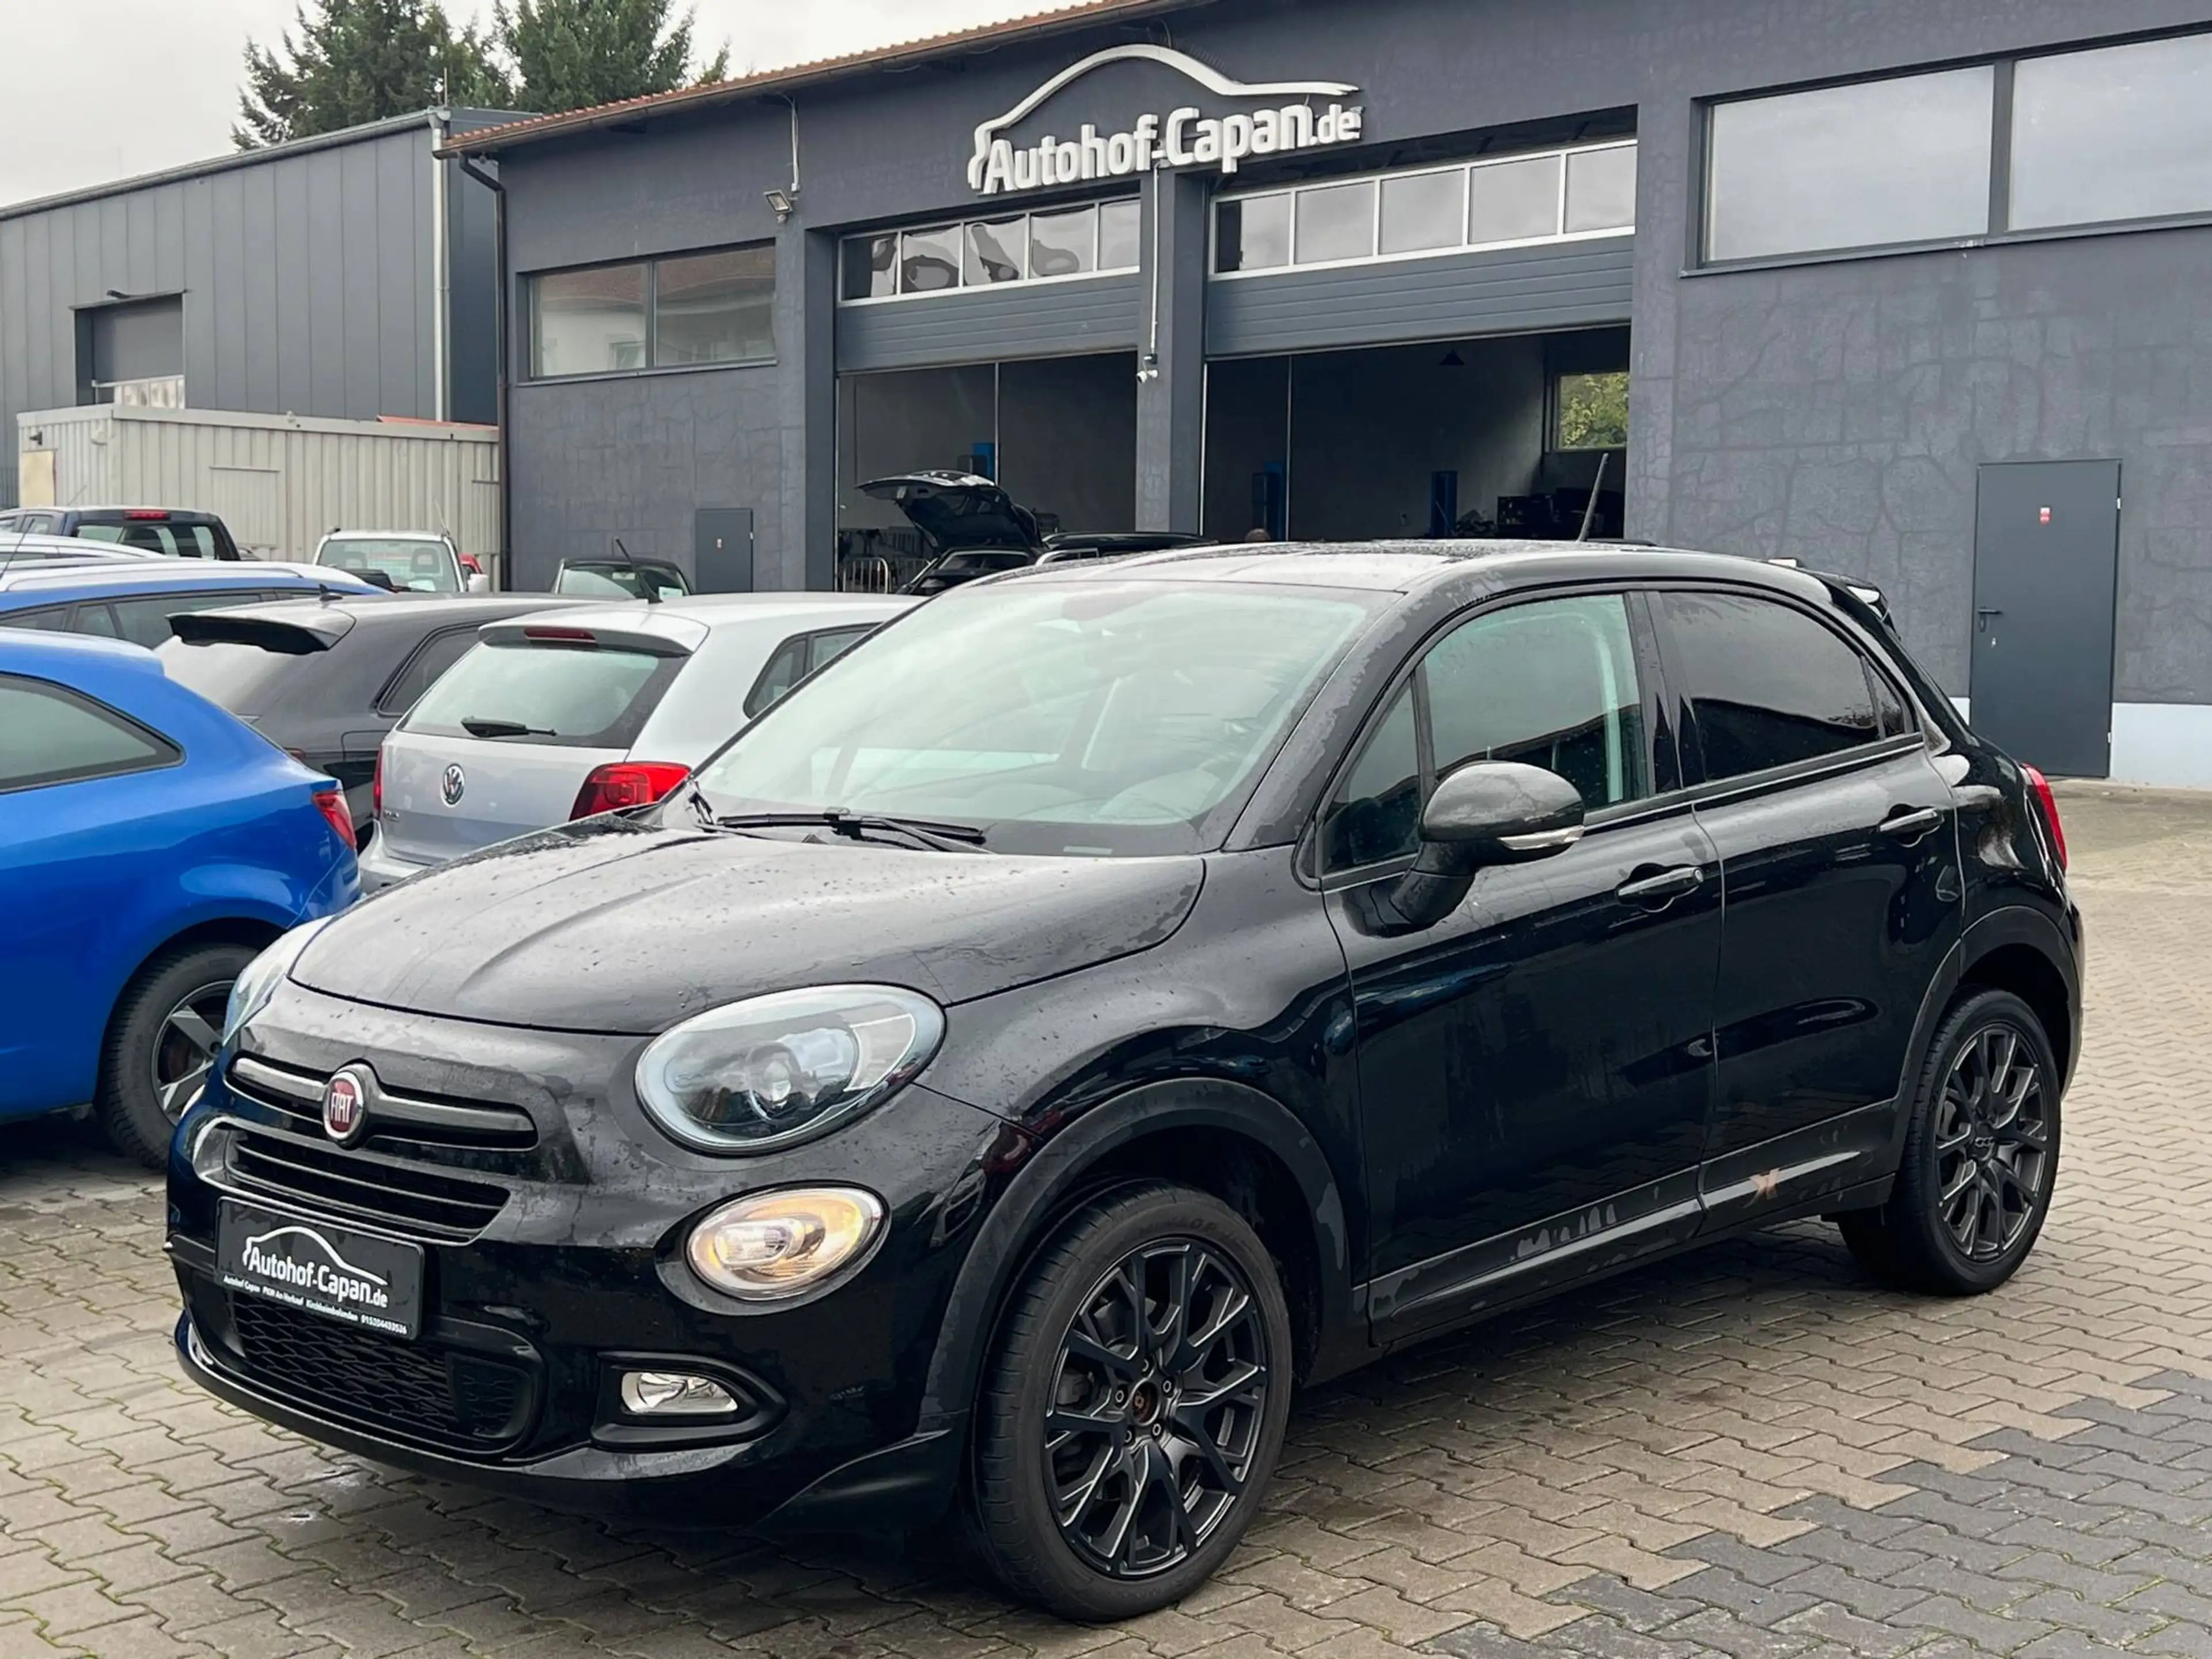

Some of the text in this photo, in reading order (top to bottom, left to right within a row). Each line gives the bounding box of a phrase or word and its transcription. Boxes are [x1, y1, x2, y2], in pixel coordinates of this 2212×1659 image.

[983, 104, 1361, 194] Autohof-Capan.de
[330, 1092, 354, 1123] FIAT
[248, 1246, 388, 1308] Autohof-Capan.de
